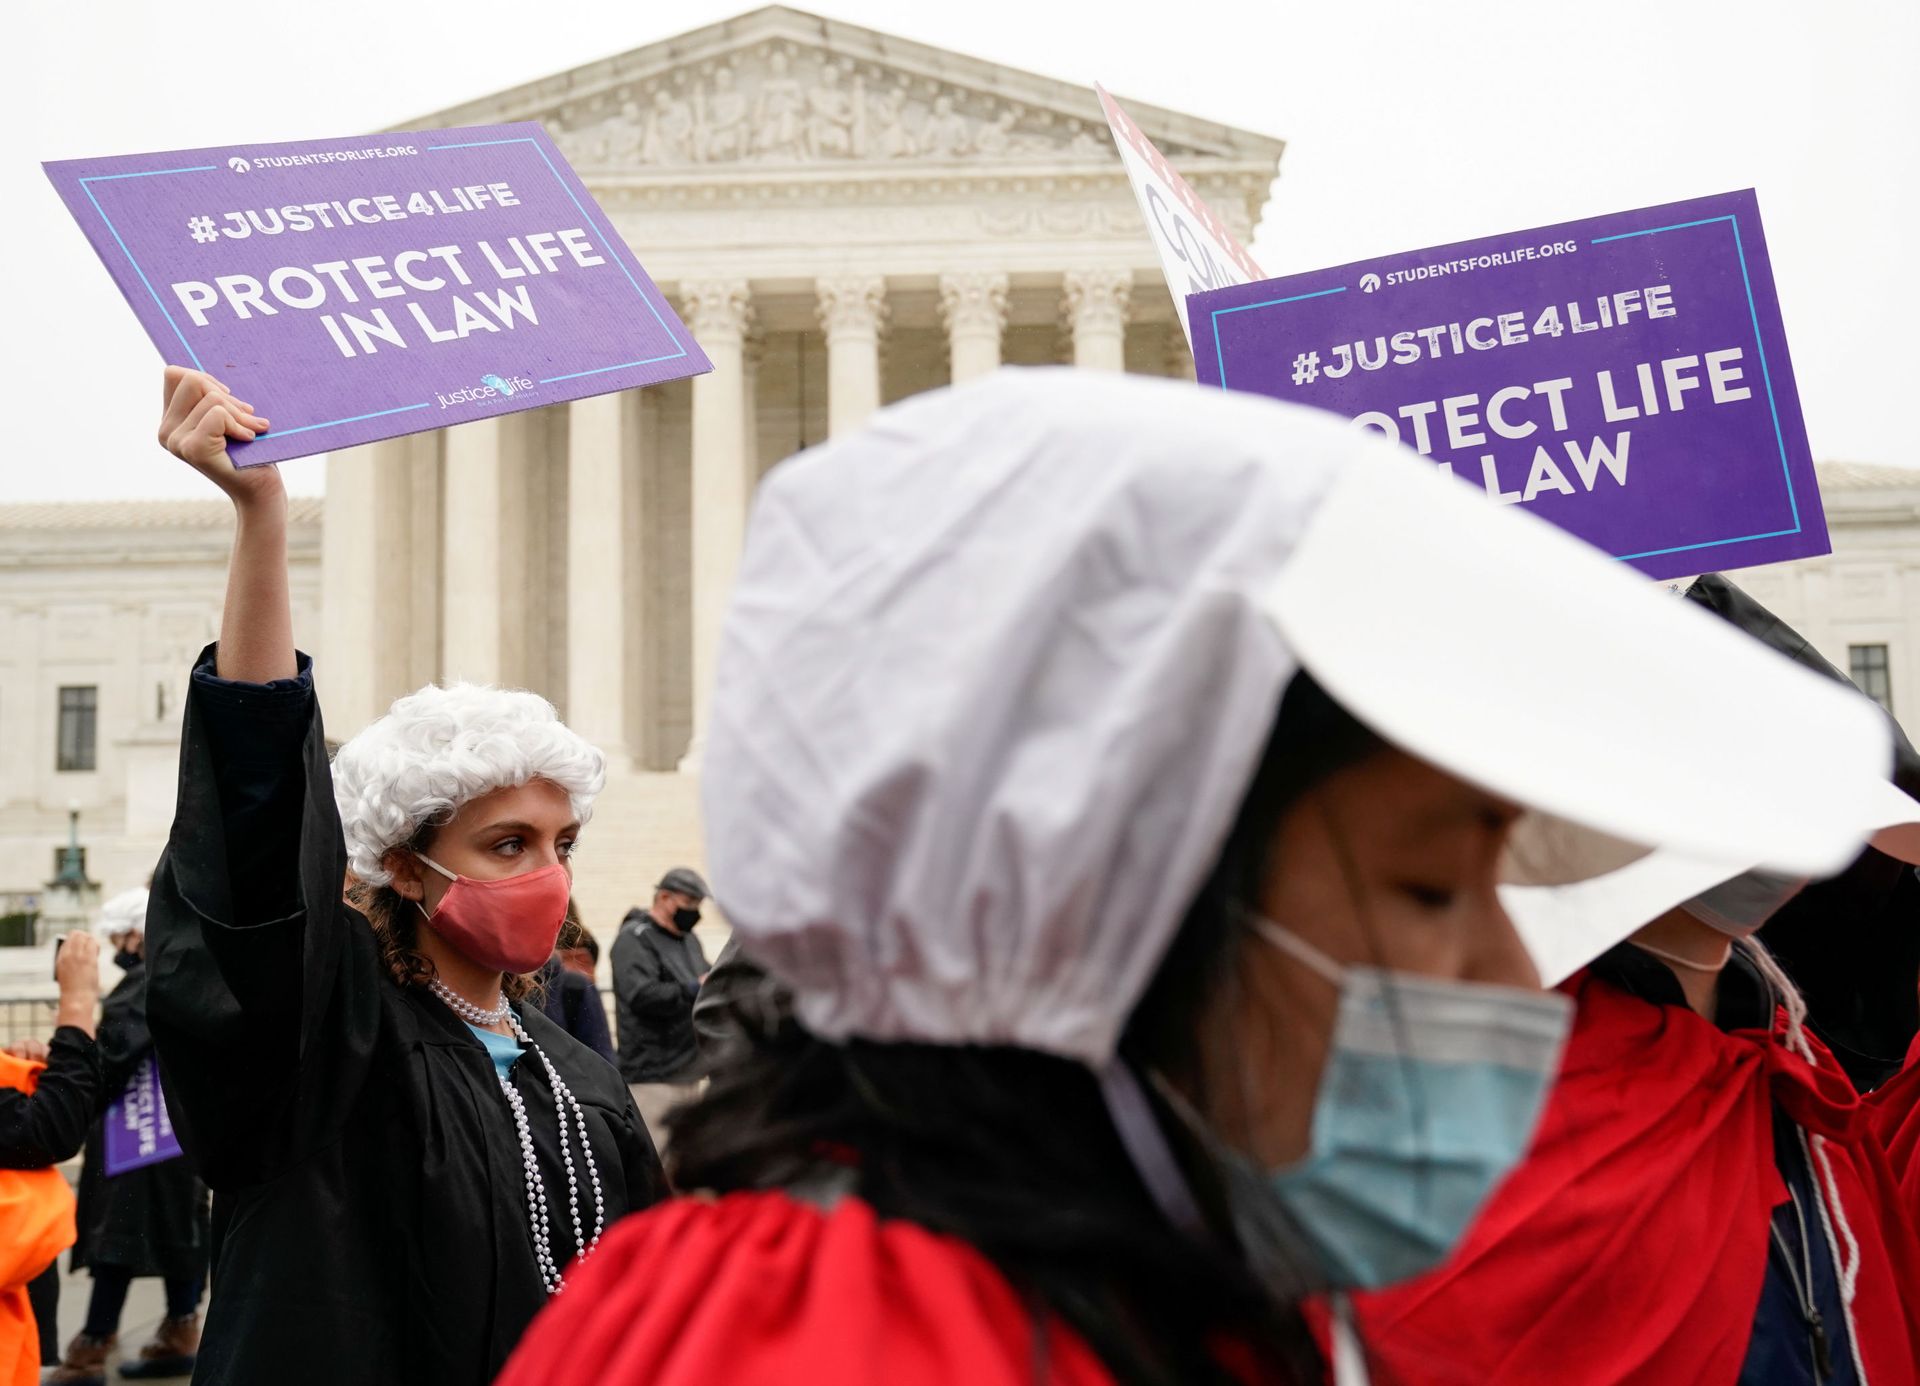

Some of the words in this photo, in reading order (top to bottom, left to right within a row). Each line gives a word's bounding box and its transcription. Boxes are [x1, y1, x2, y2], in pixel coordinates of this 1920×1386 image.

[252, 145, 419, 169] STUDENTSFORLIFE.ORG
[187, 181, 522, 244] #JUSTICE4LIFE
[171, 244, 473, 327] PROTECT
[477, 227, 607, 280] LIFE
[1386, 240, 1577, 286] STUDENTSFORLIFE.ORG
[319, 307, 408, 358] IN
[406, 284, 539, 343] LAW
[1291, 284, 1677, 386] #JUSTICE4LIFE
[1596, 347, 1752, 423] LIFE
[1480, 431, 1632, 507] LAW
